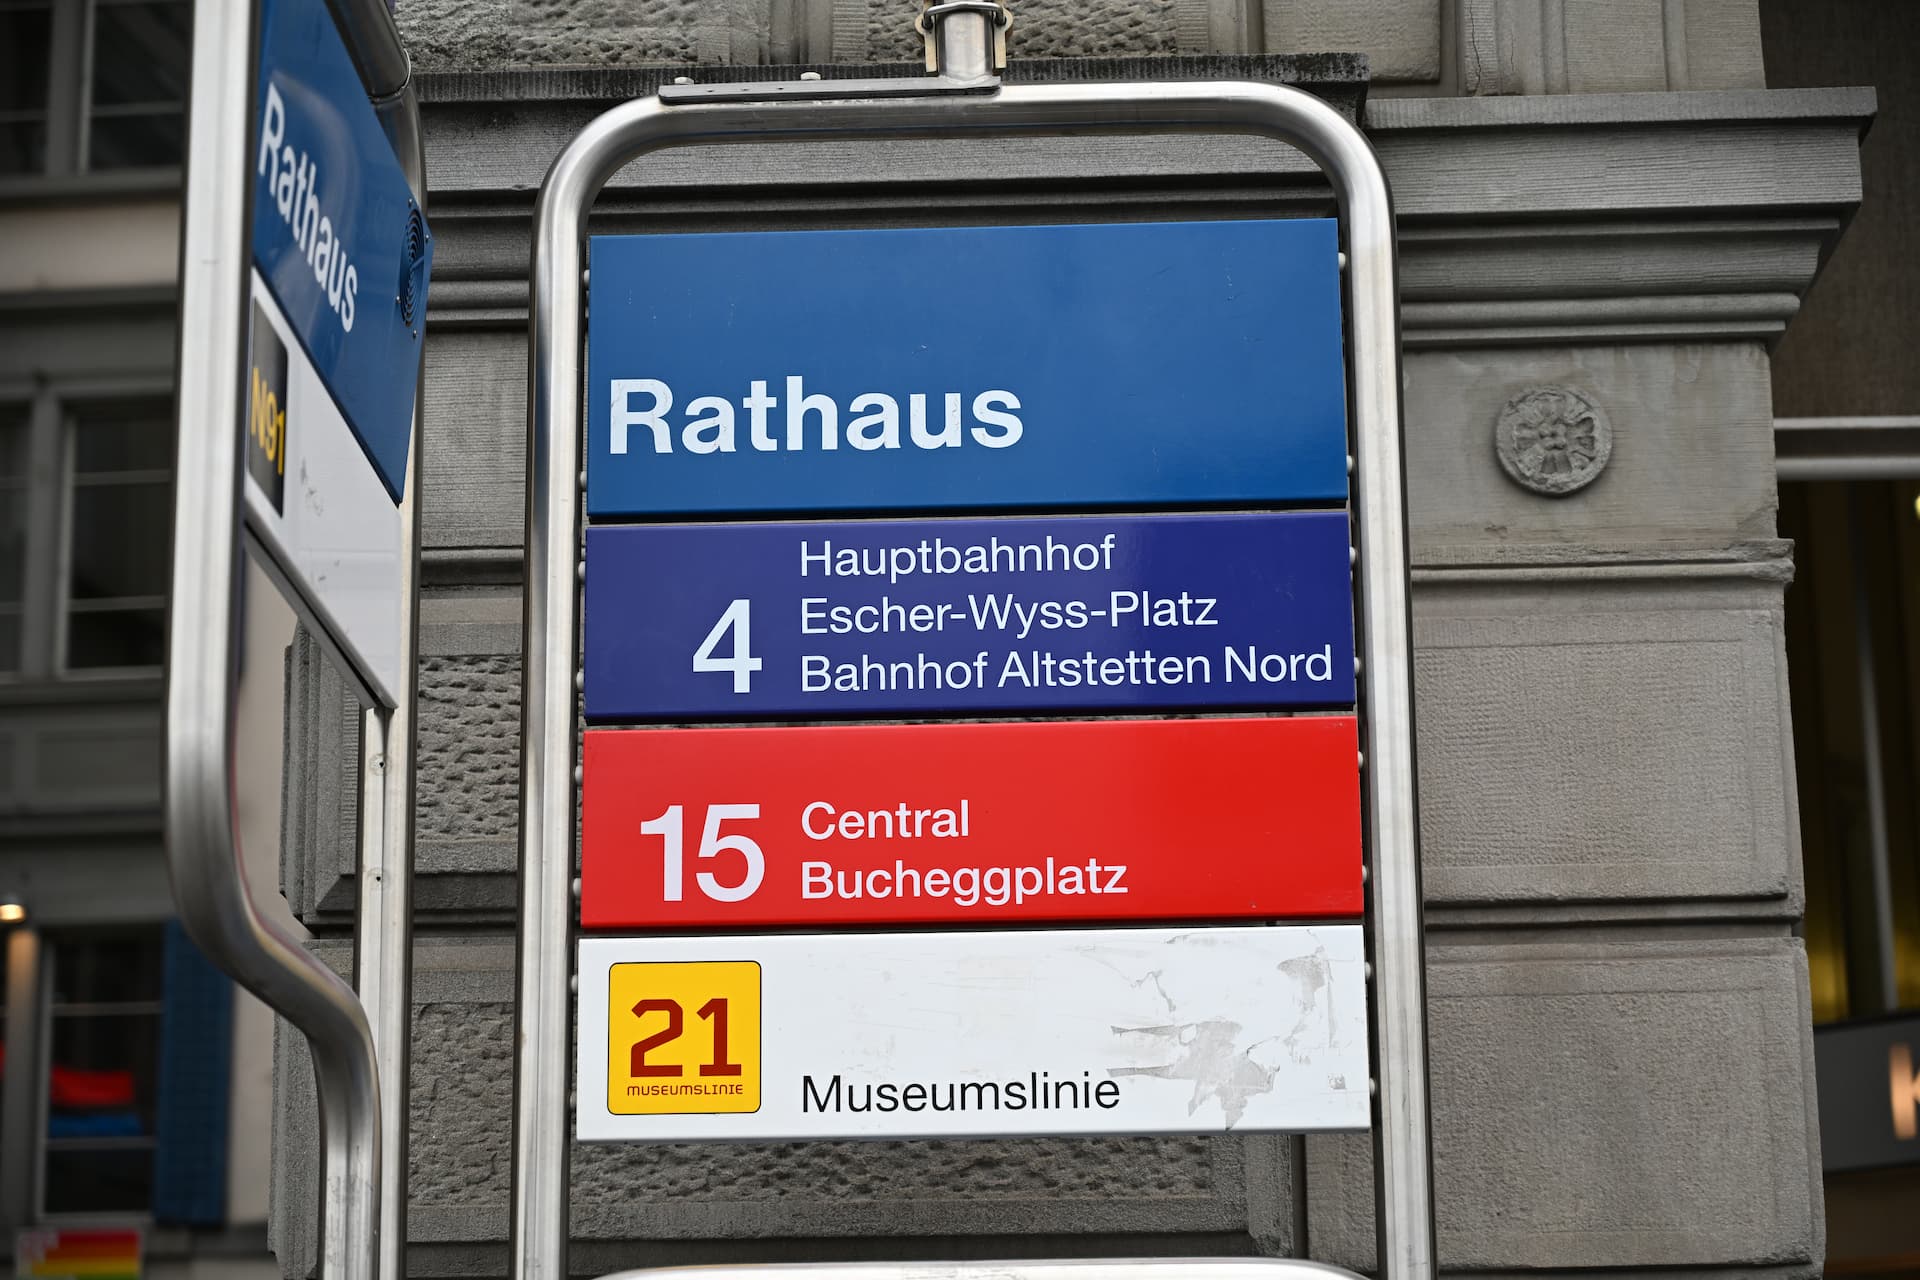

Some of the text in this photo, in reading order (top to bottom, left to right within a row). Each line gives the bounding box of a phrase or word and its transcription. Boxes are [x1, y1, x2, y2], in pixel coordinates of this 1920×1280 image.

[258, 83, 358, 333] Rathaus
[251, 367, 285, 475] N91
[610, 375, 1024, 454] Rathaus
[801, 533, 1116, 584] Hauptbahnhof
[692, 599, 763, 693] 4
[801, 590, 1219, 640] Escher-Wyss-Platz
[801, 644, 1332, 692] Bahnhof Altstetten Nord
[801, 799, 969, 840] Central
[640, 803, 766, 903] 15
[801, 856, 1128, 907] Bucheggplatz
[630, 997, 742, 1078] 21
[802, 1071, 1122, 1113] Museumslinie
